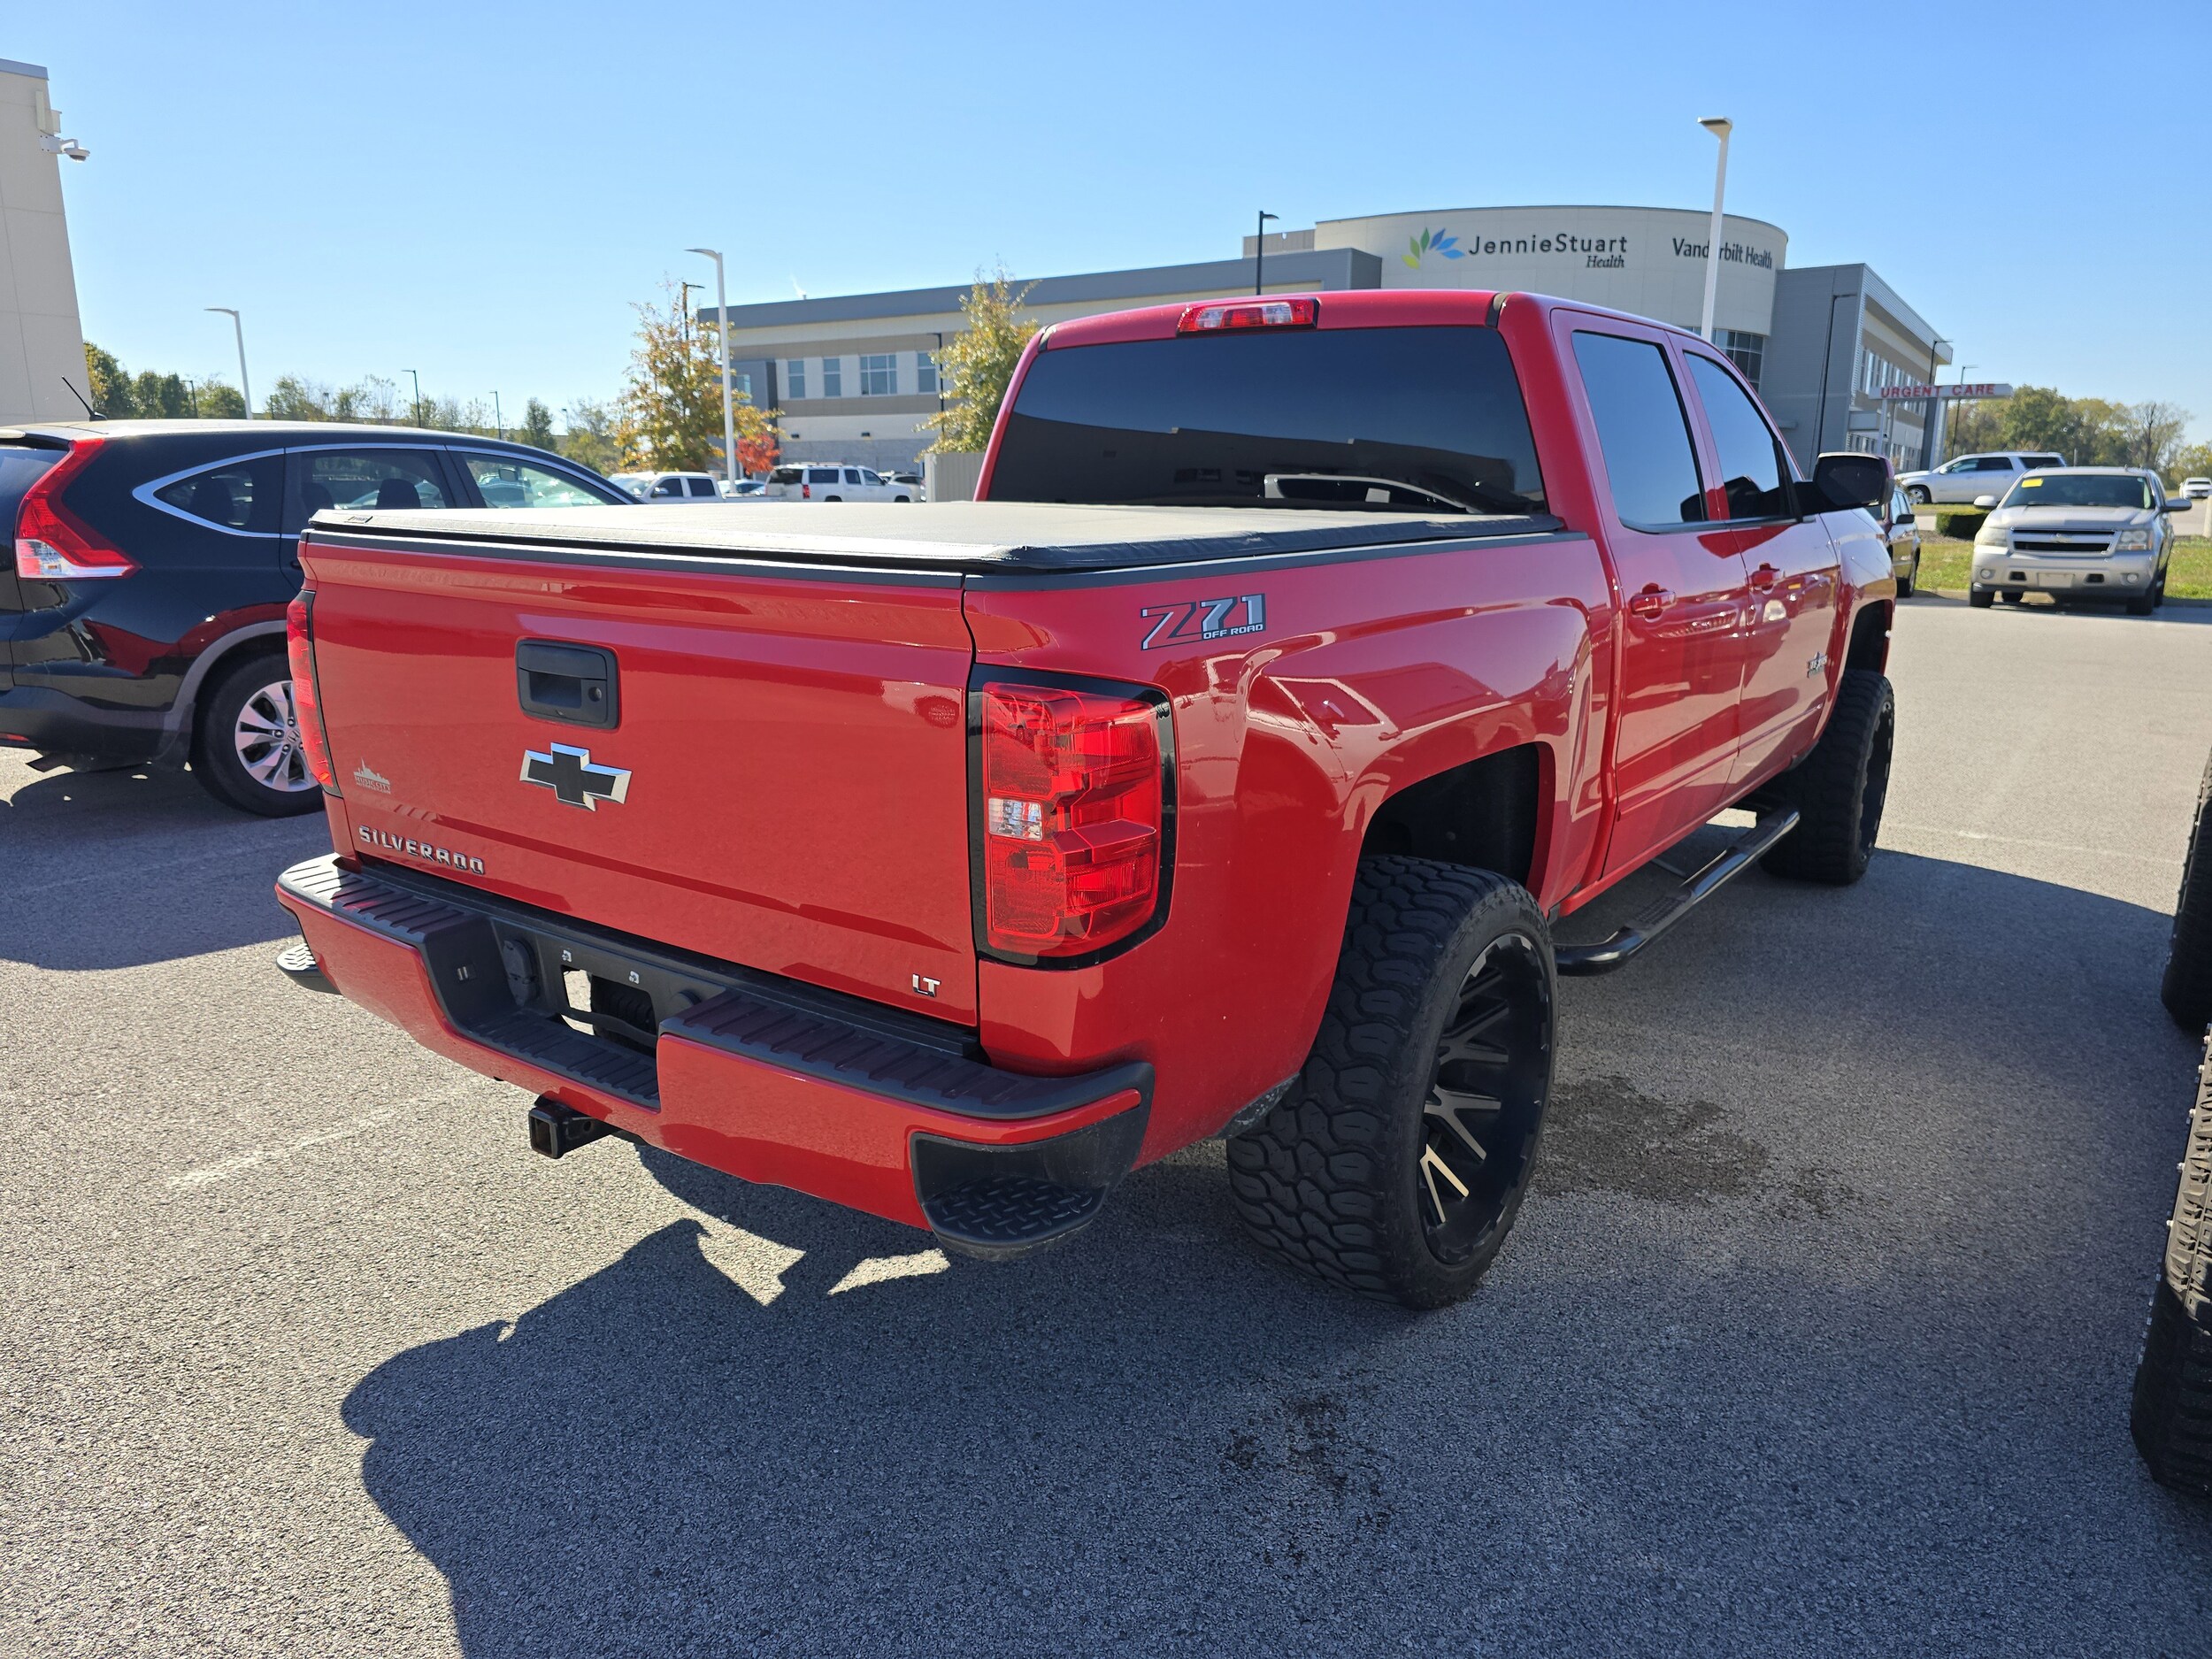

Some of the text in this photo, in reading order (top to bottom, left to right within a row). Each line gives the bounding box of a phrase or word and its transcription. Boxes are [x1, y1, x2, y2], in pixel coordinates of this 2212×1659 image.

[1469, 234, 1627, 256] JennieStuart
[1672, 237, 1772, 270] Vandrbilt Health
[1586, 255, 1624, 268] Health
[1880, 384, 1995, 398] URGENT CARE
[1141, 593, 1266, 651] Z71
[1203, 624, 1263, 640] OFF ROAD
[358, 825, 486, 875] SILVERADO
[912, 973, 941, 997] LT
